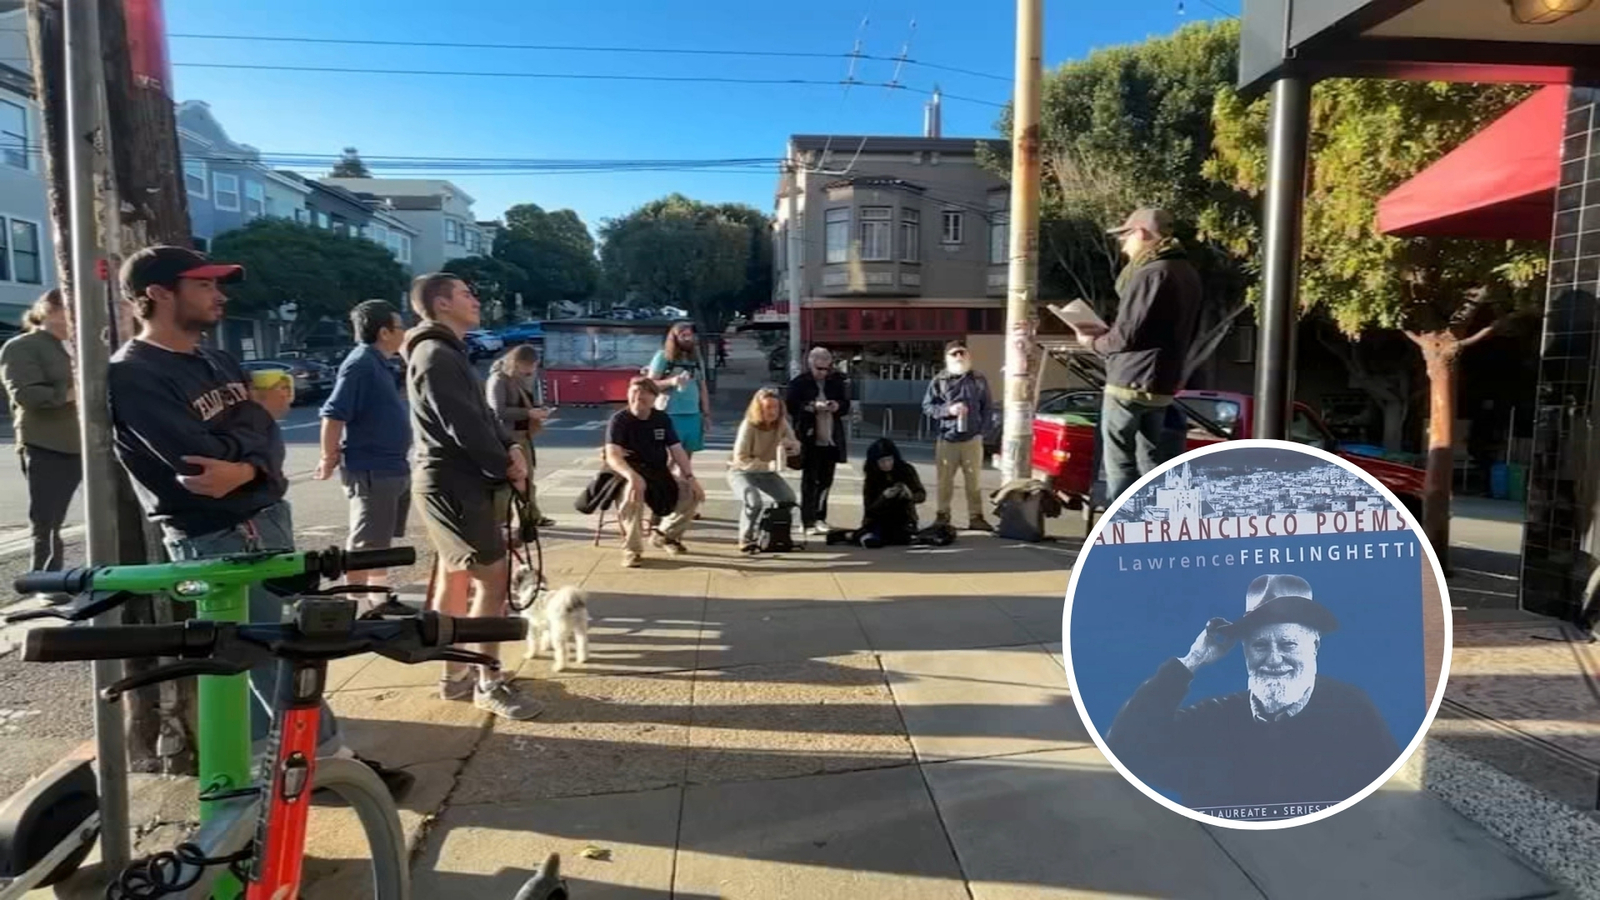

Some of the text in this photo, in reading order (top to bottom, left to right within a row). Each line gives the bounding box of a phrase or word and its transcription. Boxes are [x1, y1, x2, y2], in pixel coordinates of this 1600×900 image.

[1145, 513, 1298, 543] FRANCISCO
[1317, 509, 1406, 535] POEMS
[1119, 542, 1414, 571] Lawrence FERLINGHETTI
[1283, 805, 1321, 816] SERIES
